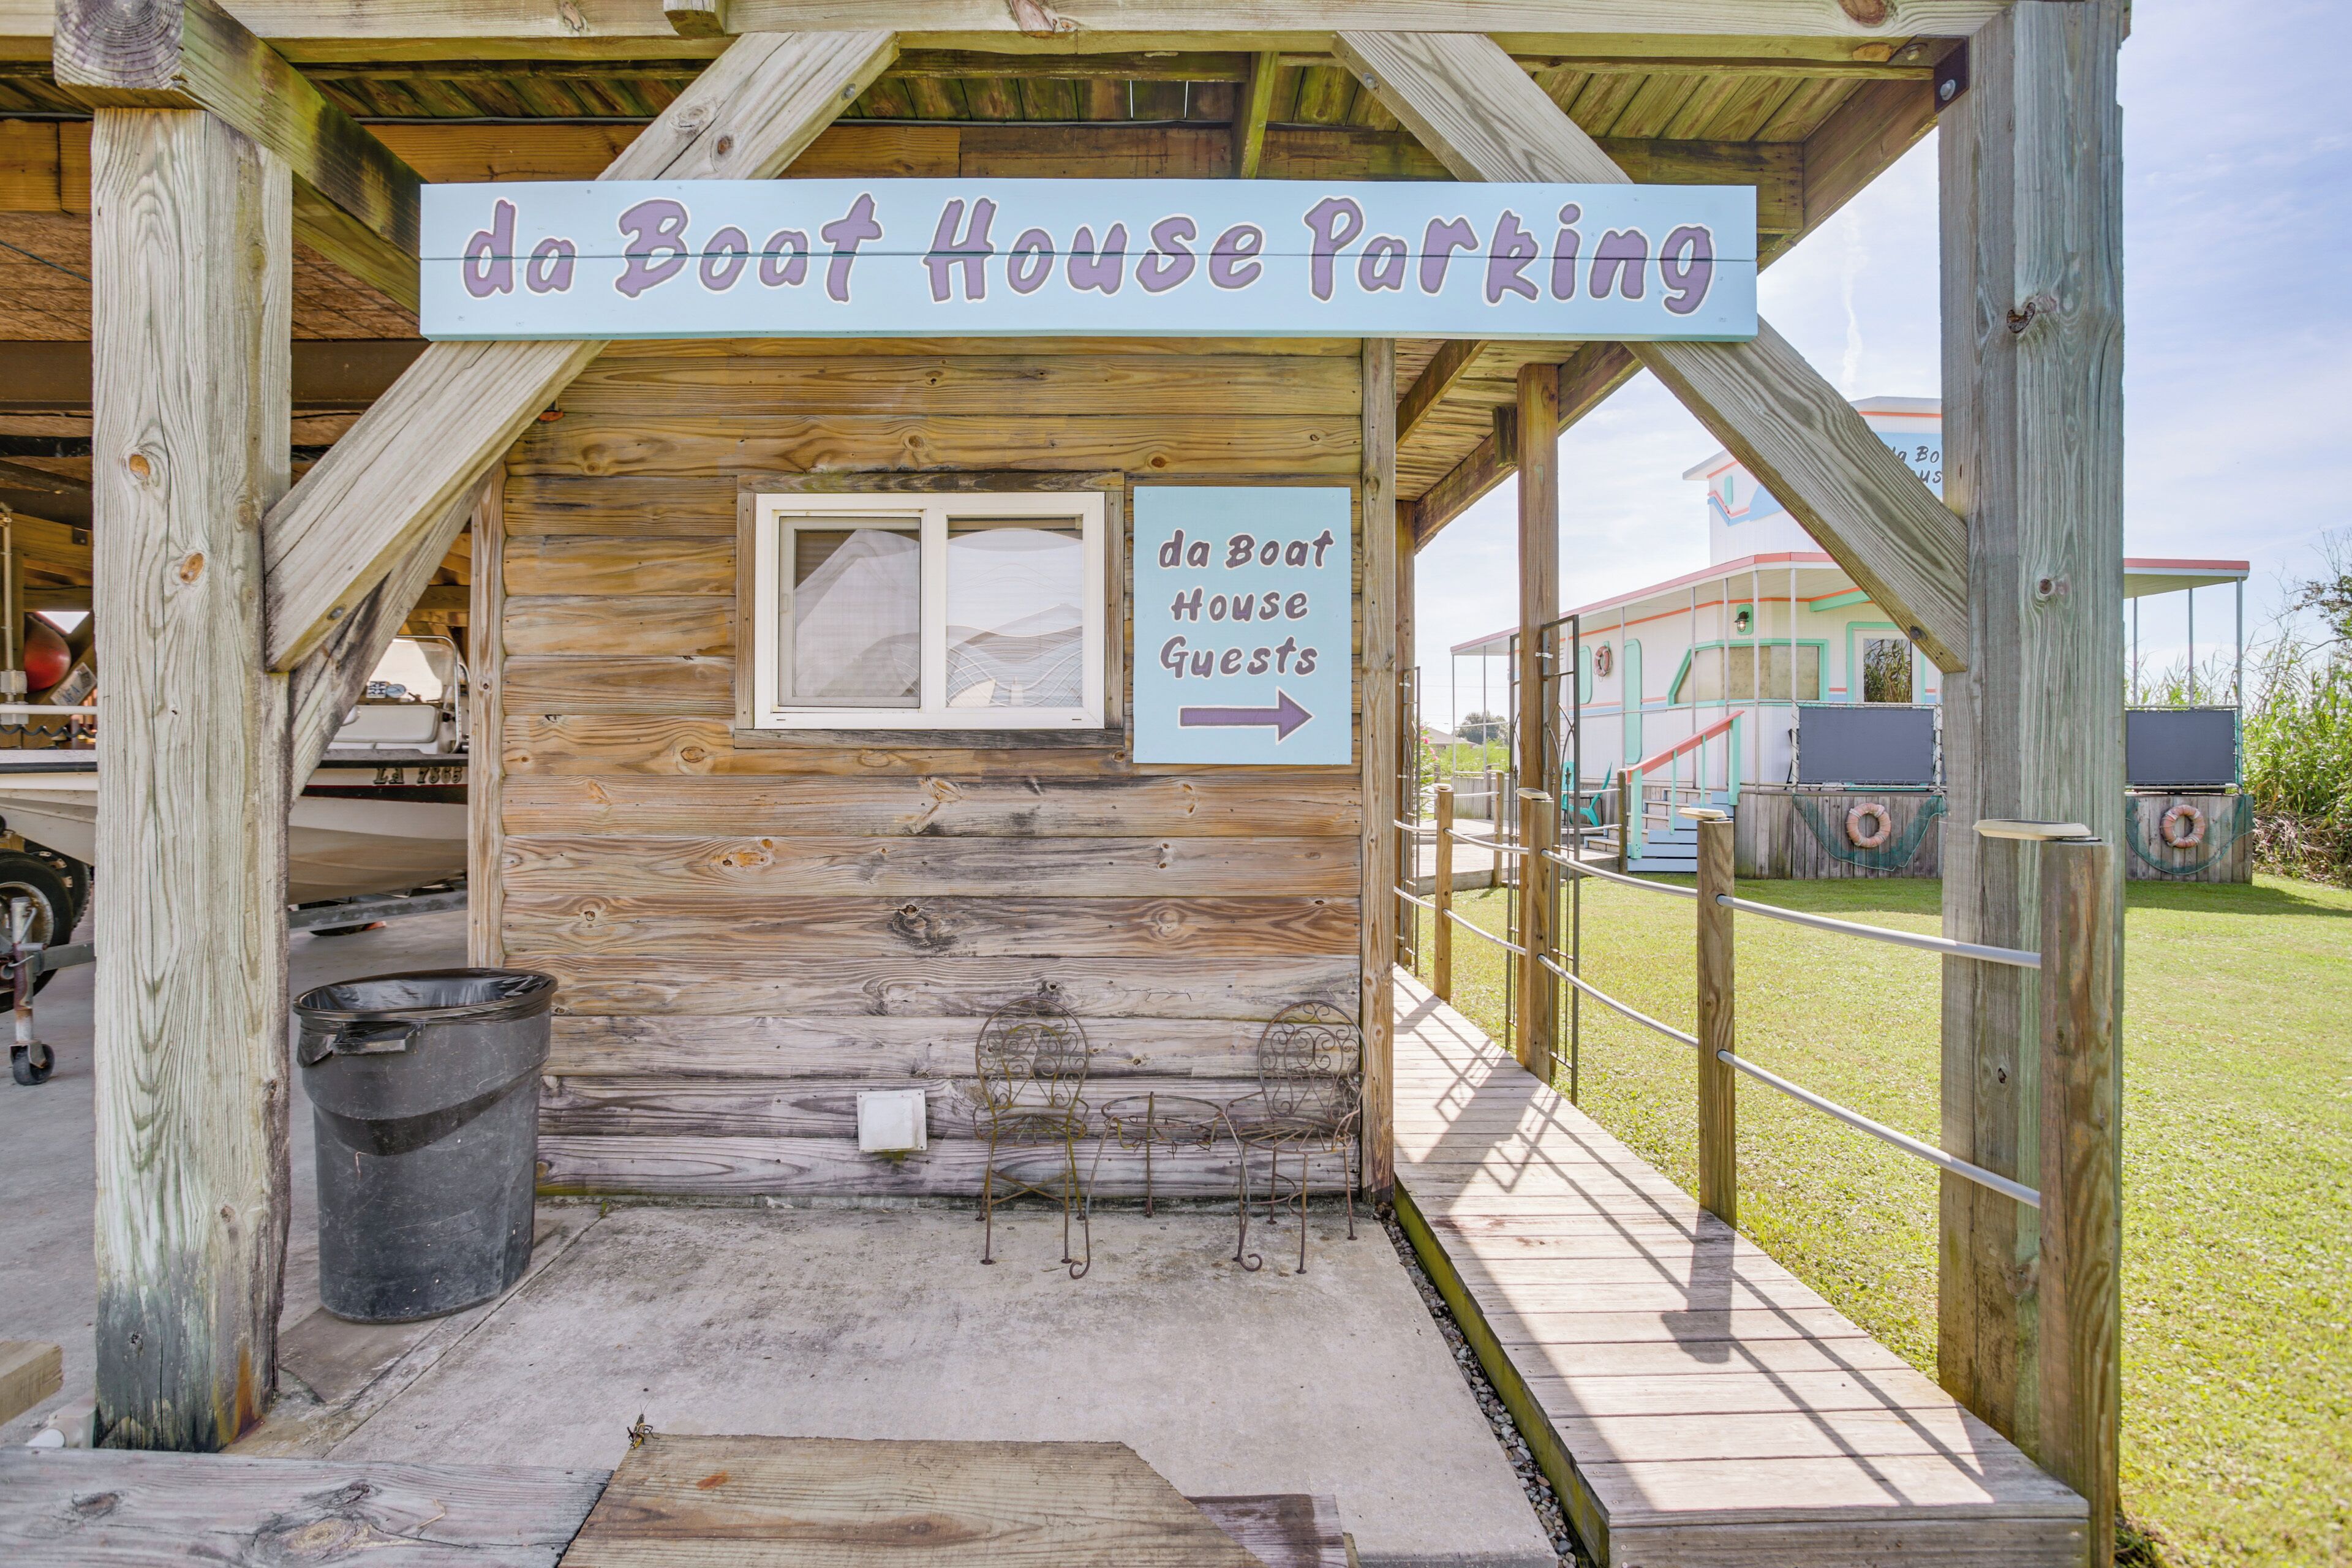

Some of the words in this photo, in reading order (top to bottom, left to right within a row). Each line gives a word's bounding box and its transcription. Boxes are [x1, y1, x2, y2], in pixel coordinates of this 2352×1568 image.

[463, 199, 576, 298] da
[614, 193, 882, 303] Boat
[922, 196, 1263, 302] House
[1303, 196, 1714, 315] Parking
[1159, 529, 1210, 568] da
[1225, 529, 1335, 568] Boat
[1170, 587, 1308, 622] House
[1161, 635, 1317, 679] Guests
[374, 767, 404, 785] LA
